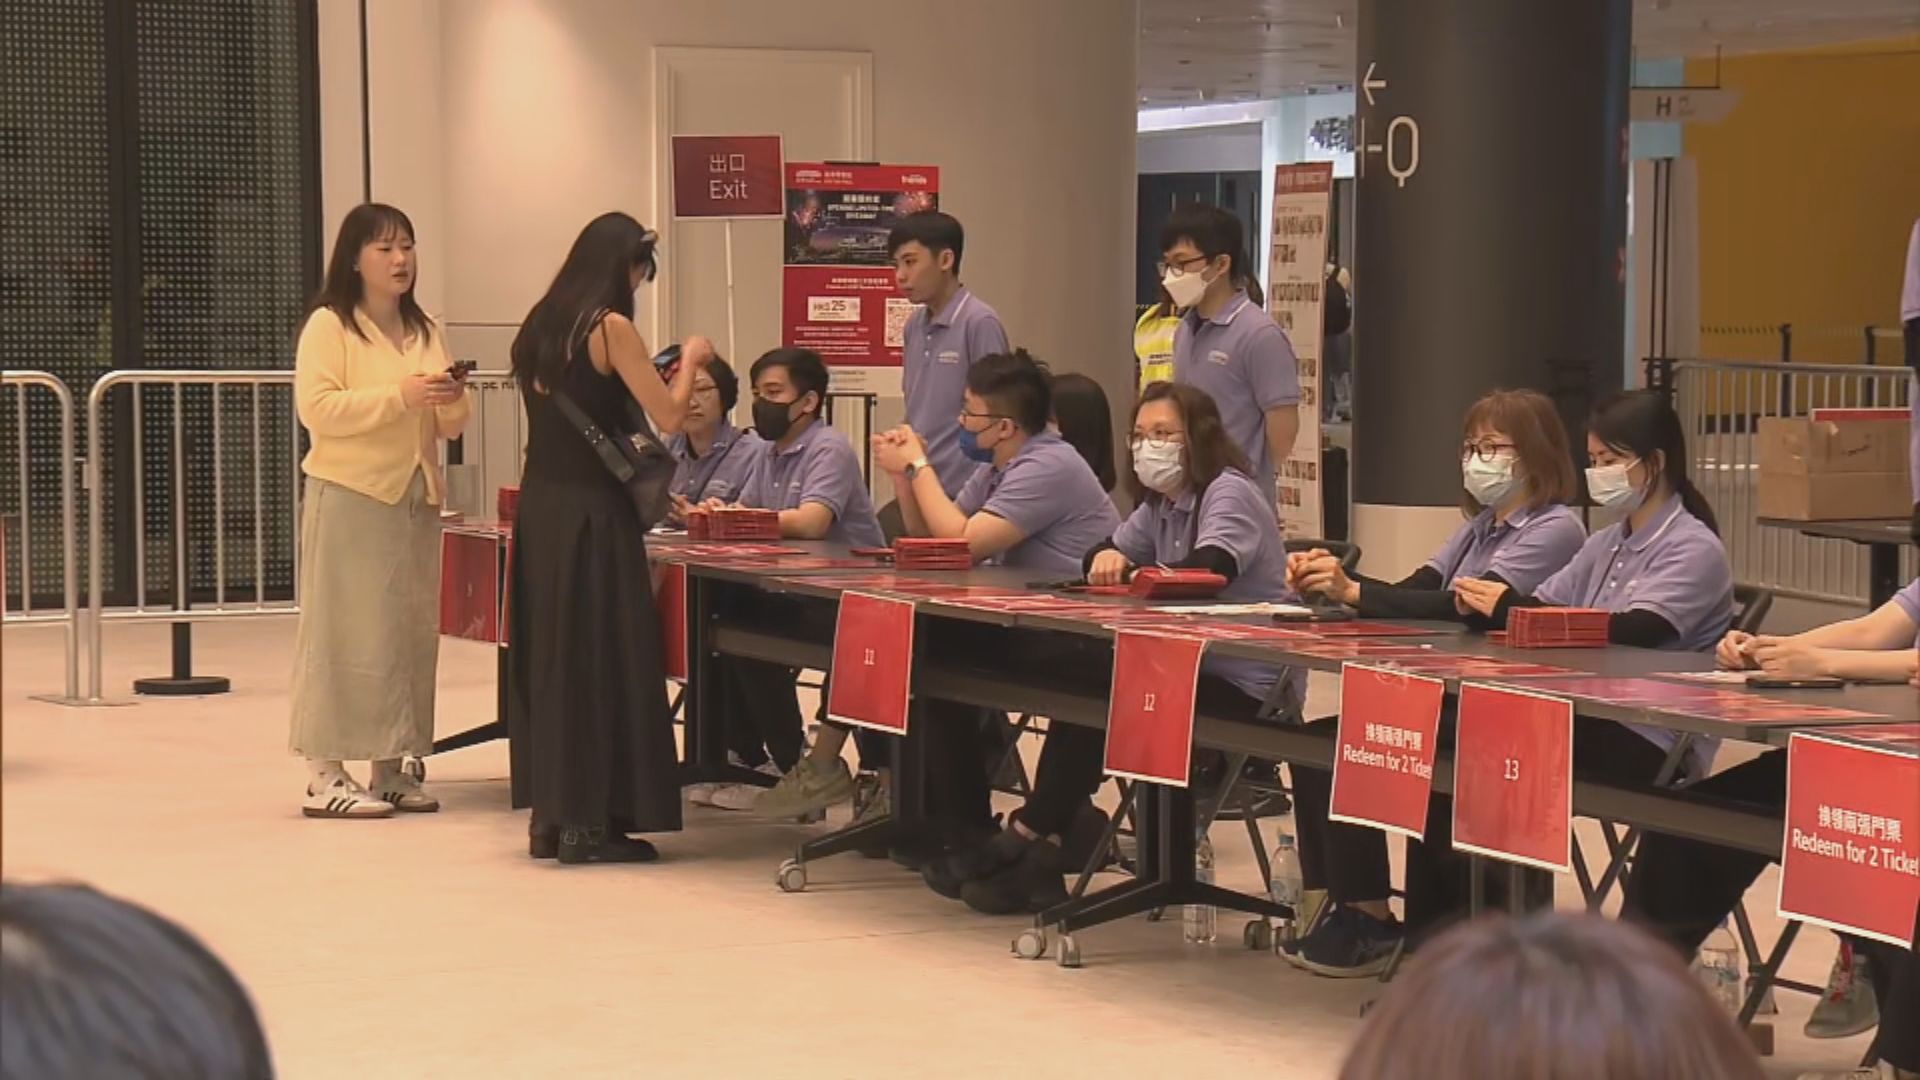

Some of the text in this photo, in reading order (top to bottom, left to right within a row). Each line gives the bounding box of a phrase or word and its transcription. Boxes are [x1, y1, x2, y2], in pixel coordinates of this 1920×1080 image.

[1656, 95, 1672, 117] H
[709, 153, 745, 173] 出口
[709, 179, 748, 200] Exit
[1143, 693, 1155, 711] 12
[1343, 743, 1385, 768] Redeem
[1385, 750, 1401, 771] for
[1401, 754, 1409, 774] 2
[1504, 758, 1519, 781] 13
[1792, 828, 1844, 859] Redeem
[1846, 840, 1867, 865] for
[1869, 845, 1879, 867] 2
